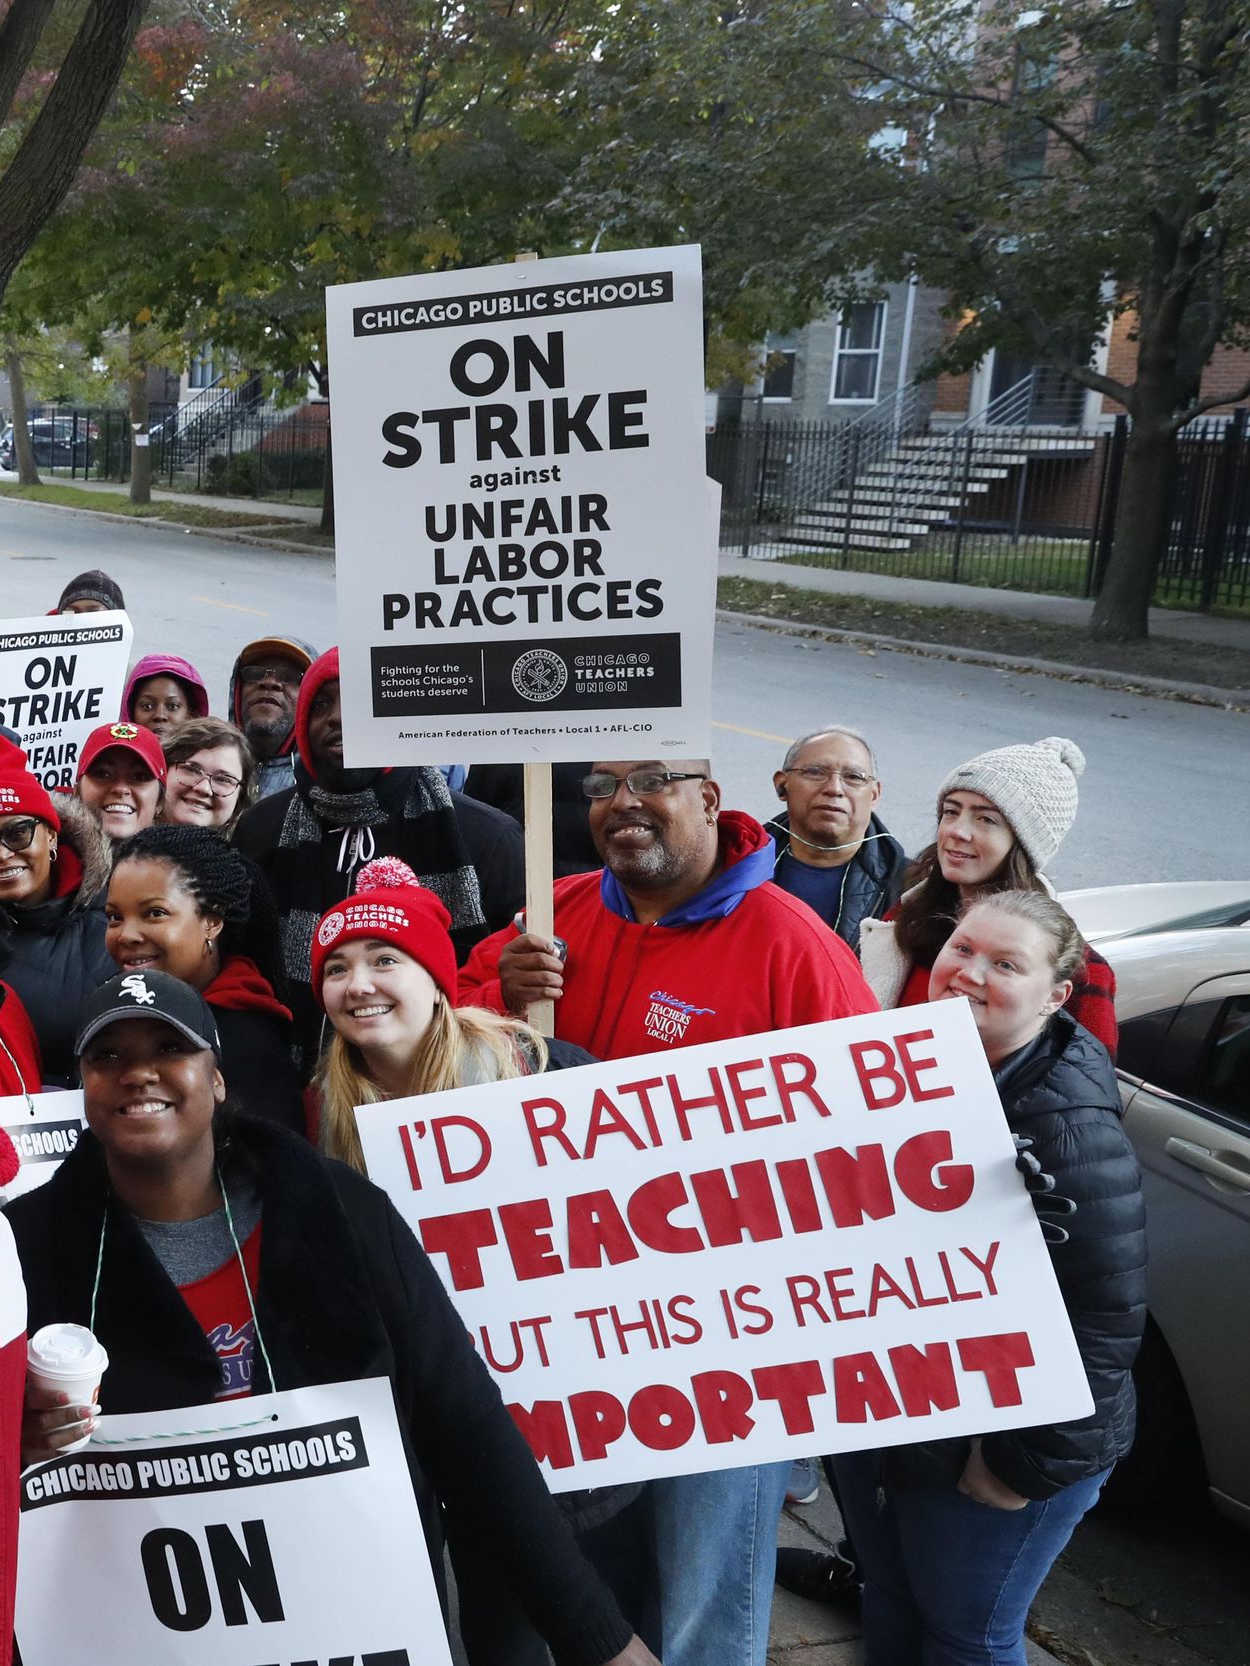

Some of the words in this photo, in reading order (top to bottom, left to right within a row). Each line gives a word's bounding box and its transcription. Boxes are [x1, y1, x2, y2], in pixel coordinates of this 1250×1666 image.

[361, 303, 463, 330] CHICAGO
[470, 292, 547, 318] PUBLIC
[553, 278, 664, 307] SCHOOLS
[450, 331, 565, 397] ON
[381, 390, 649, 468] STRIKE
[470, 464, 561, 492] against
[425, 493, 610, 542] UNFAIR
[434, 539, 605, 585] LABOR
[383, 579, 664, 630] PRACTICES
[38, 632, 75, 646] PUBLIC
[76, 628, 120, 642] SCHOOLS
[24, 655, 77, 690] ON
[381, 666, 422, 678] Fighting
[425, 664, 438, 674] for
[441, 663, 460, 673] the
[575, 653, 650, 666] CHICAGO
[381, 676, 420, 687] schools
[422, 674, 473, 687] Chicago's
[575, 667, 654, 680] TEACHERS
[575, 681, 628, 693] UNION
[381, 687, 425, 698] students
[428, 686, 468, 697] deserve
[23, 728, 62, 743] against
[398, 730, 443, 739] American
[445, 728, 498, 738] Federation
[500, 728, 509, 736] of
[512, 726, 556, 735] Teachers
[566, 725, 592, 734] Local
[610, 724, 653, 733] AFL-CIO
[27, 742, 77, 769] FAIR
[346, 904, 404, 916] CHICAGO
[346, 912, 410, 927] TEACHERS
[346, 921, 387, 930] UNION
[644, 1012, 687, 1039] UNION
[650, 1002, 691, 1025] TEACHERS
[647, 1028, 669, 1042] LOCAL
[398, 1115, 492, 1191] I'D
[521, 1052, 831, 1167] RATHER
[850, 1029, 955, 1111] BE
[11, 1128, 78, 1157] SCHOOLS
[418, 1130, 975, 1291] TEACHING
[469, 1315, 553, 1373] UT
[575, 1294, 704, 1359] THIS
[719, 1284, 774, 1340] IS
[787, 1242, 1002, 1328] REALLY
[505, 1331, 1036, 1470] MPORTANT
[26, 1463, 134, 1501] CHICAGO
[141, 1452, 231, 1489] PUBLIC
[236, 1431, 357, 1477] SCHOOLS
[140, 1519, 285, 1632] ON
